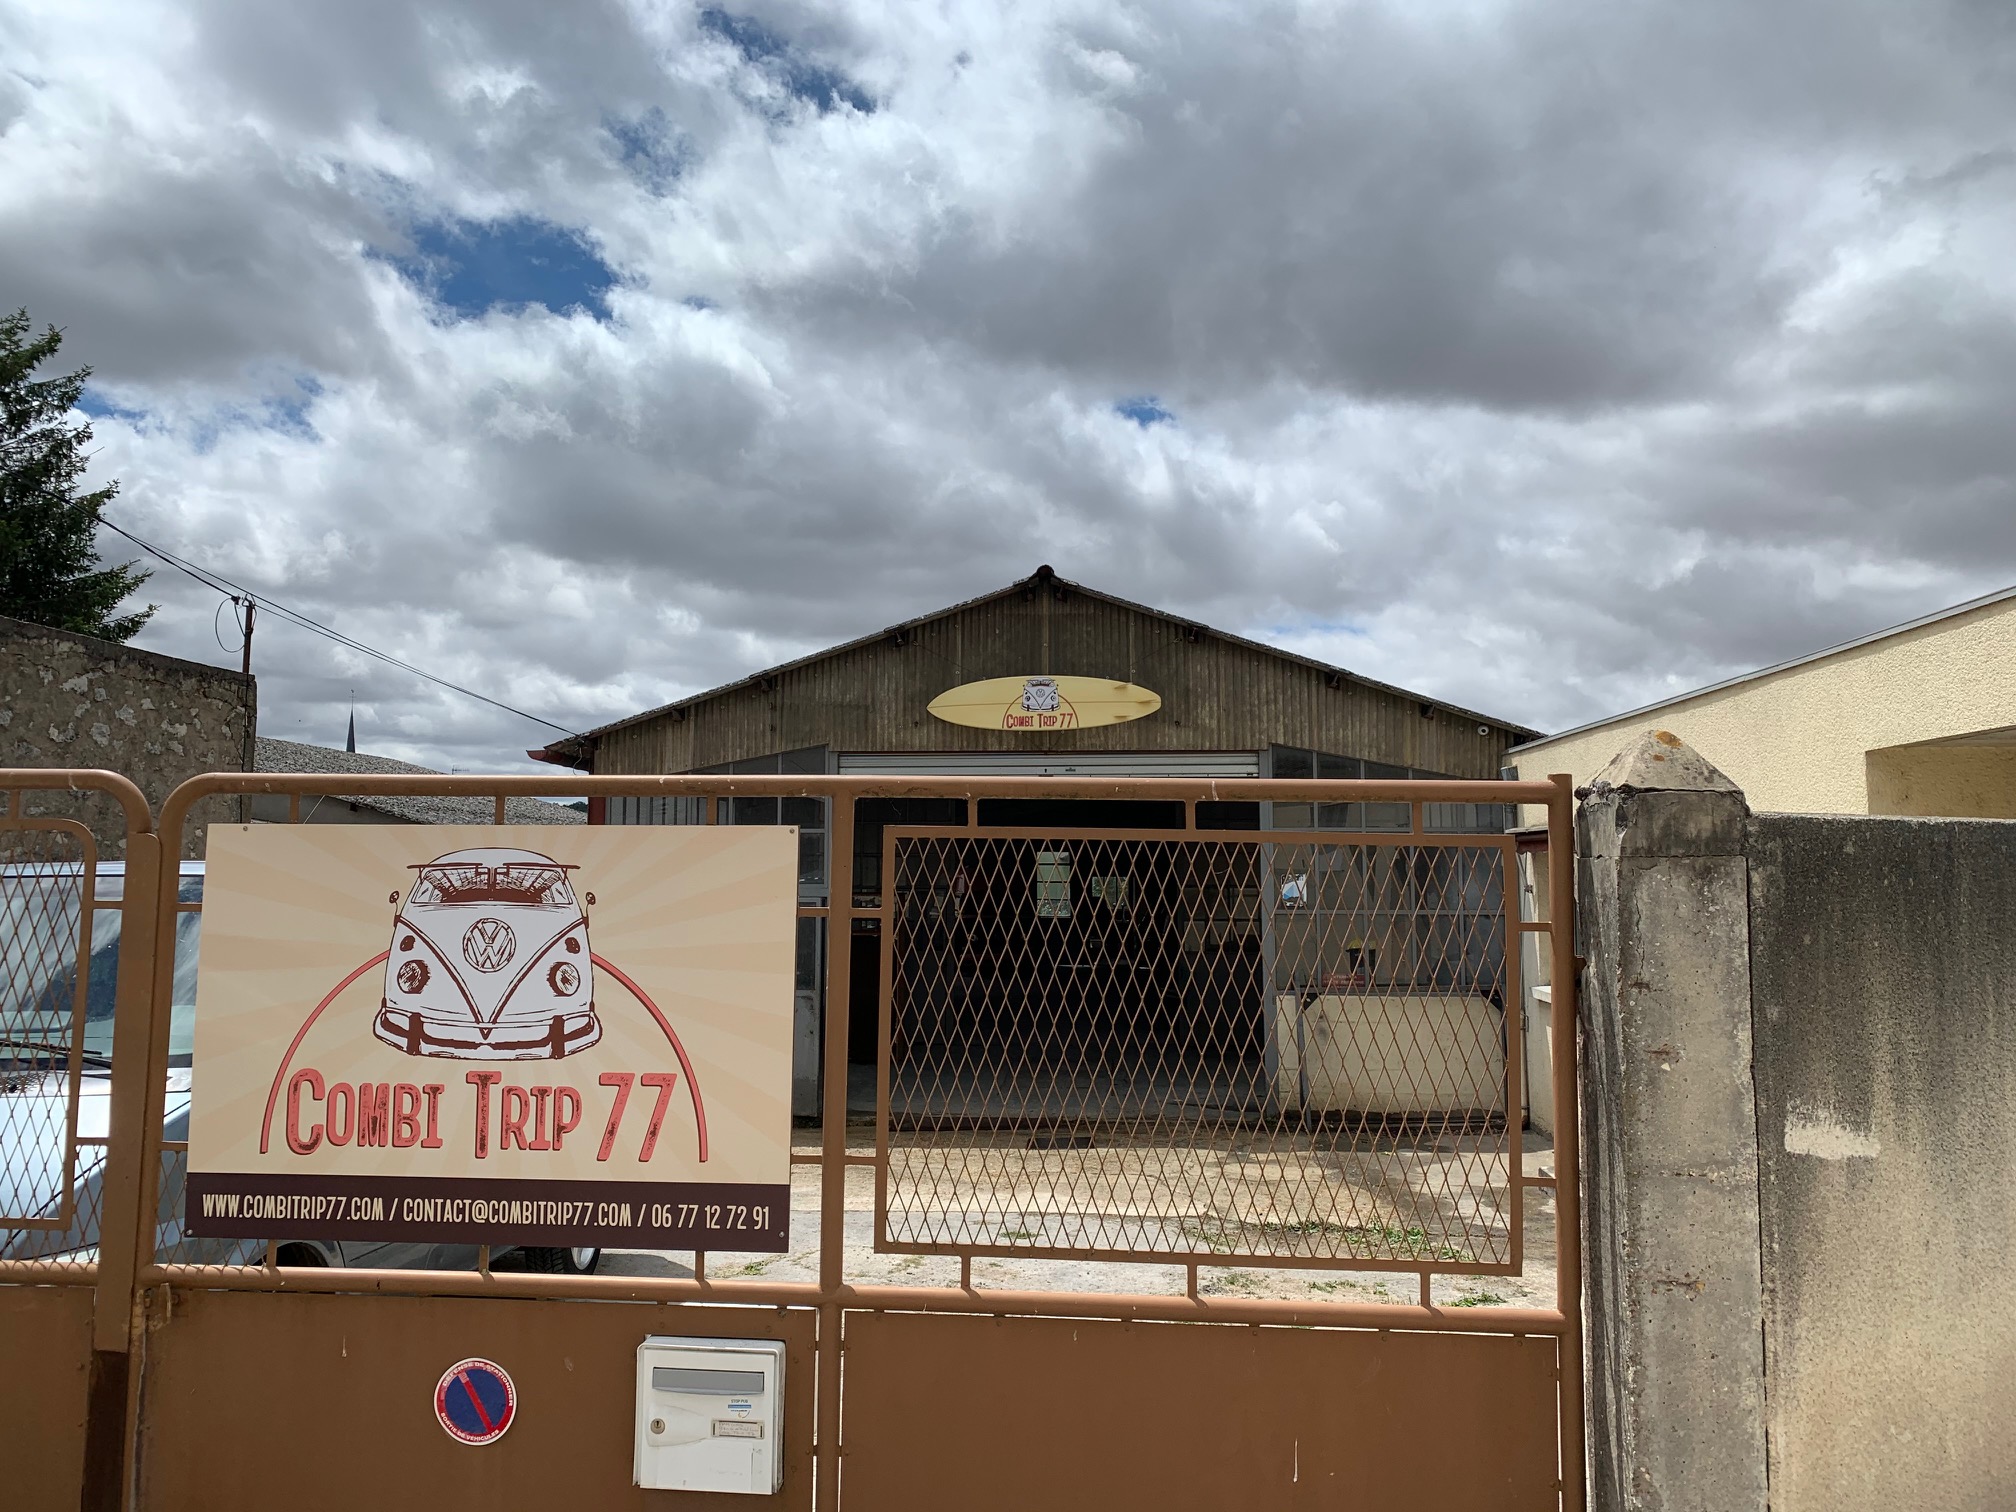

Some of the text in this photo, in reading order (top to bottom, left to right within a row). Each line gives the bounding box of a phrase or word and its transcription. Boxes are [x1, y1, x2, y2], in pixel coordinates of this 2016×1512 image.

[1006, 712, 1073, 729] COMBI TRIP 77
[463, 917, 517, 974] VW
[285, 1067, 678, 1162] COMBI TRIP 77
[202, 1193, 770, 1230] WWW.COMBITRIP77.COM / CONTACT@COMBITRIP77.COM / 06 77 12 72 91
